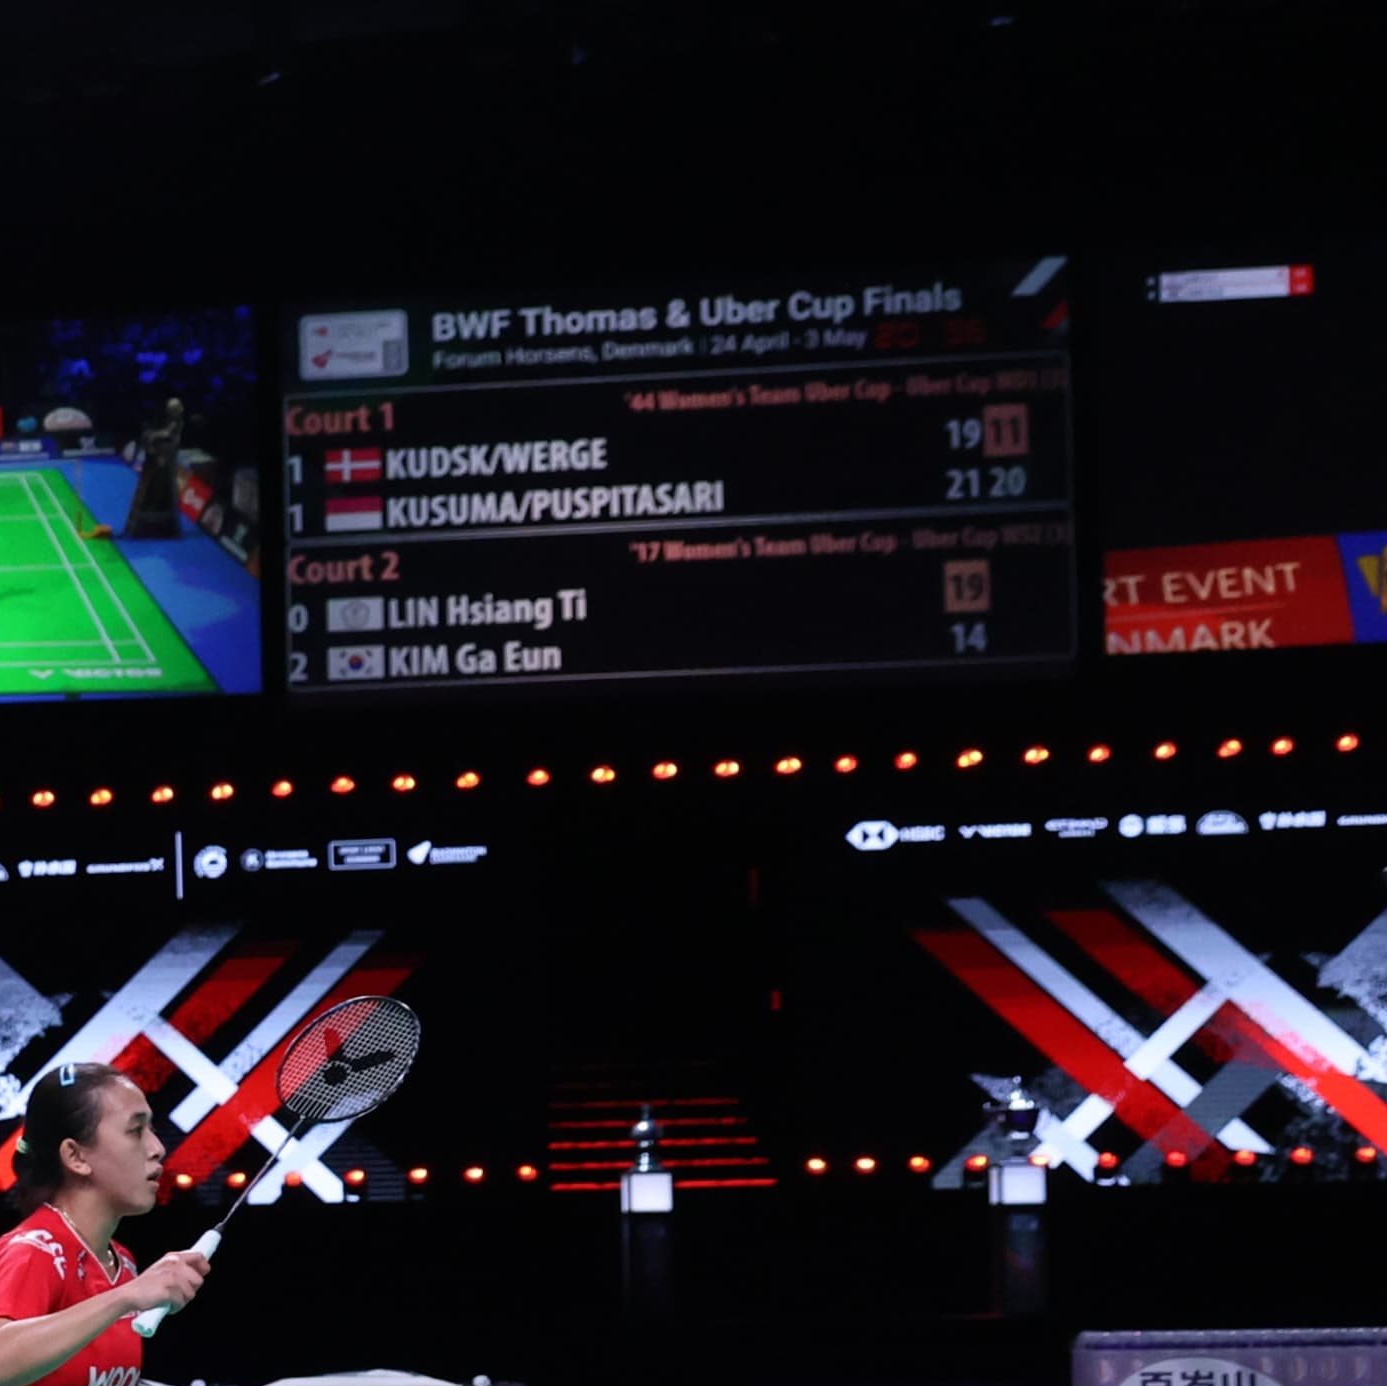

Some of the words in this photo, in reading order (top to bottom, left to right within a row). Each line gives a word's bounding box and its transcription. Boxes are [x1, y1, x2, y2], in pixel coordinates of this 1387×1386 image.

[431, 309, 512, 342] BWF
[518, 304, 659, 336] Thomas
[665, 298, 692, 330] &
[699, 292, 781, 327] Uber
[787, 289, 855, 323] Cup
[862, 282, 964, 317] Finals
[432, 347, 503, 371] Forum
[602, 336, 695, 361] Denmark
[710, 332, 738, 355] 24
[741, 329, 791, 355] April
[803, 327, 818, 350] 3
[822, 326, 869, 350] May
[286, 406, 371, 438] Court
[379, 402, 396, 432] 1
[944, 417, 982, 450] 19
[990, 415, 1023, 447] 11
[288, 454, 304, 485] 1
[386, 437, 609, 480] KUDSK/WERGE
[945, 467, 981, 500] 21
[989, 466, 1026, 498] 20
[288, 503, 304, 533] 1
[386, 480, 725, 528] KUSUMA/PUSPITASARI
[288, 553, 375, 585] Court
[380, 550, 401, 582] 2
[1161, 562, 1300, 604] EVENT
[950, 572, 984, 603] 19
[288, 603, 309, 633] 0
[387, 596, 439, 630] LIN
[446, 592, 554, 631] Hsiang
[557, 587, 588, 622] Ti
[949, 621, 988, 654] 14
[1106, 618, 1275, 655] NMARK
[288, 651, 310, 683] 2
[389, 644, 449, 679] KIM
[455, 641, 497, 675] Ga
[503, 640, 563, 673] Eun
